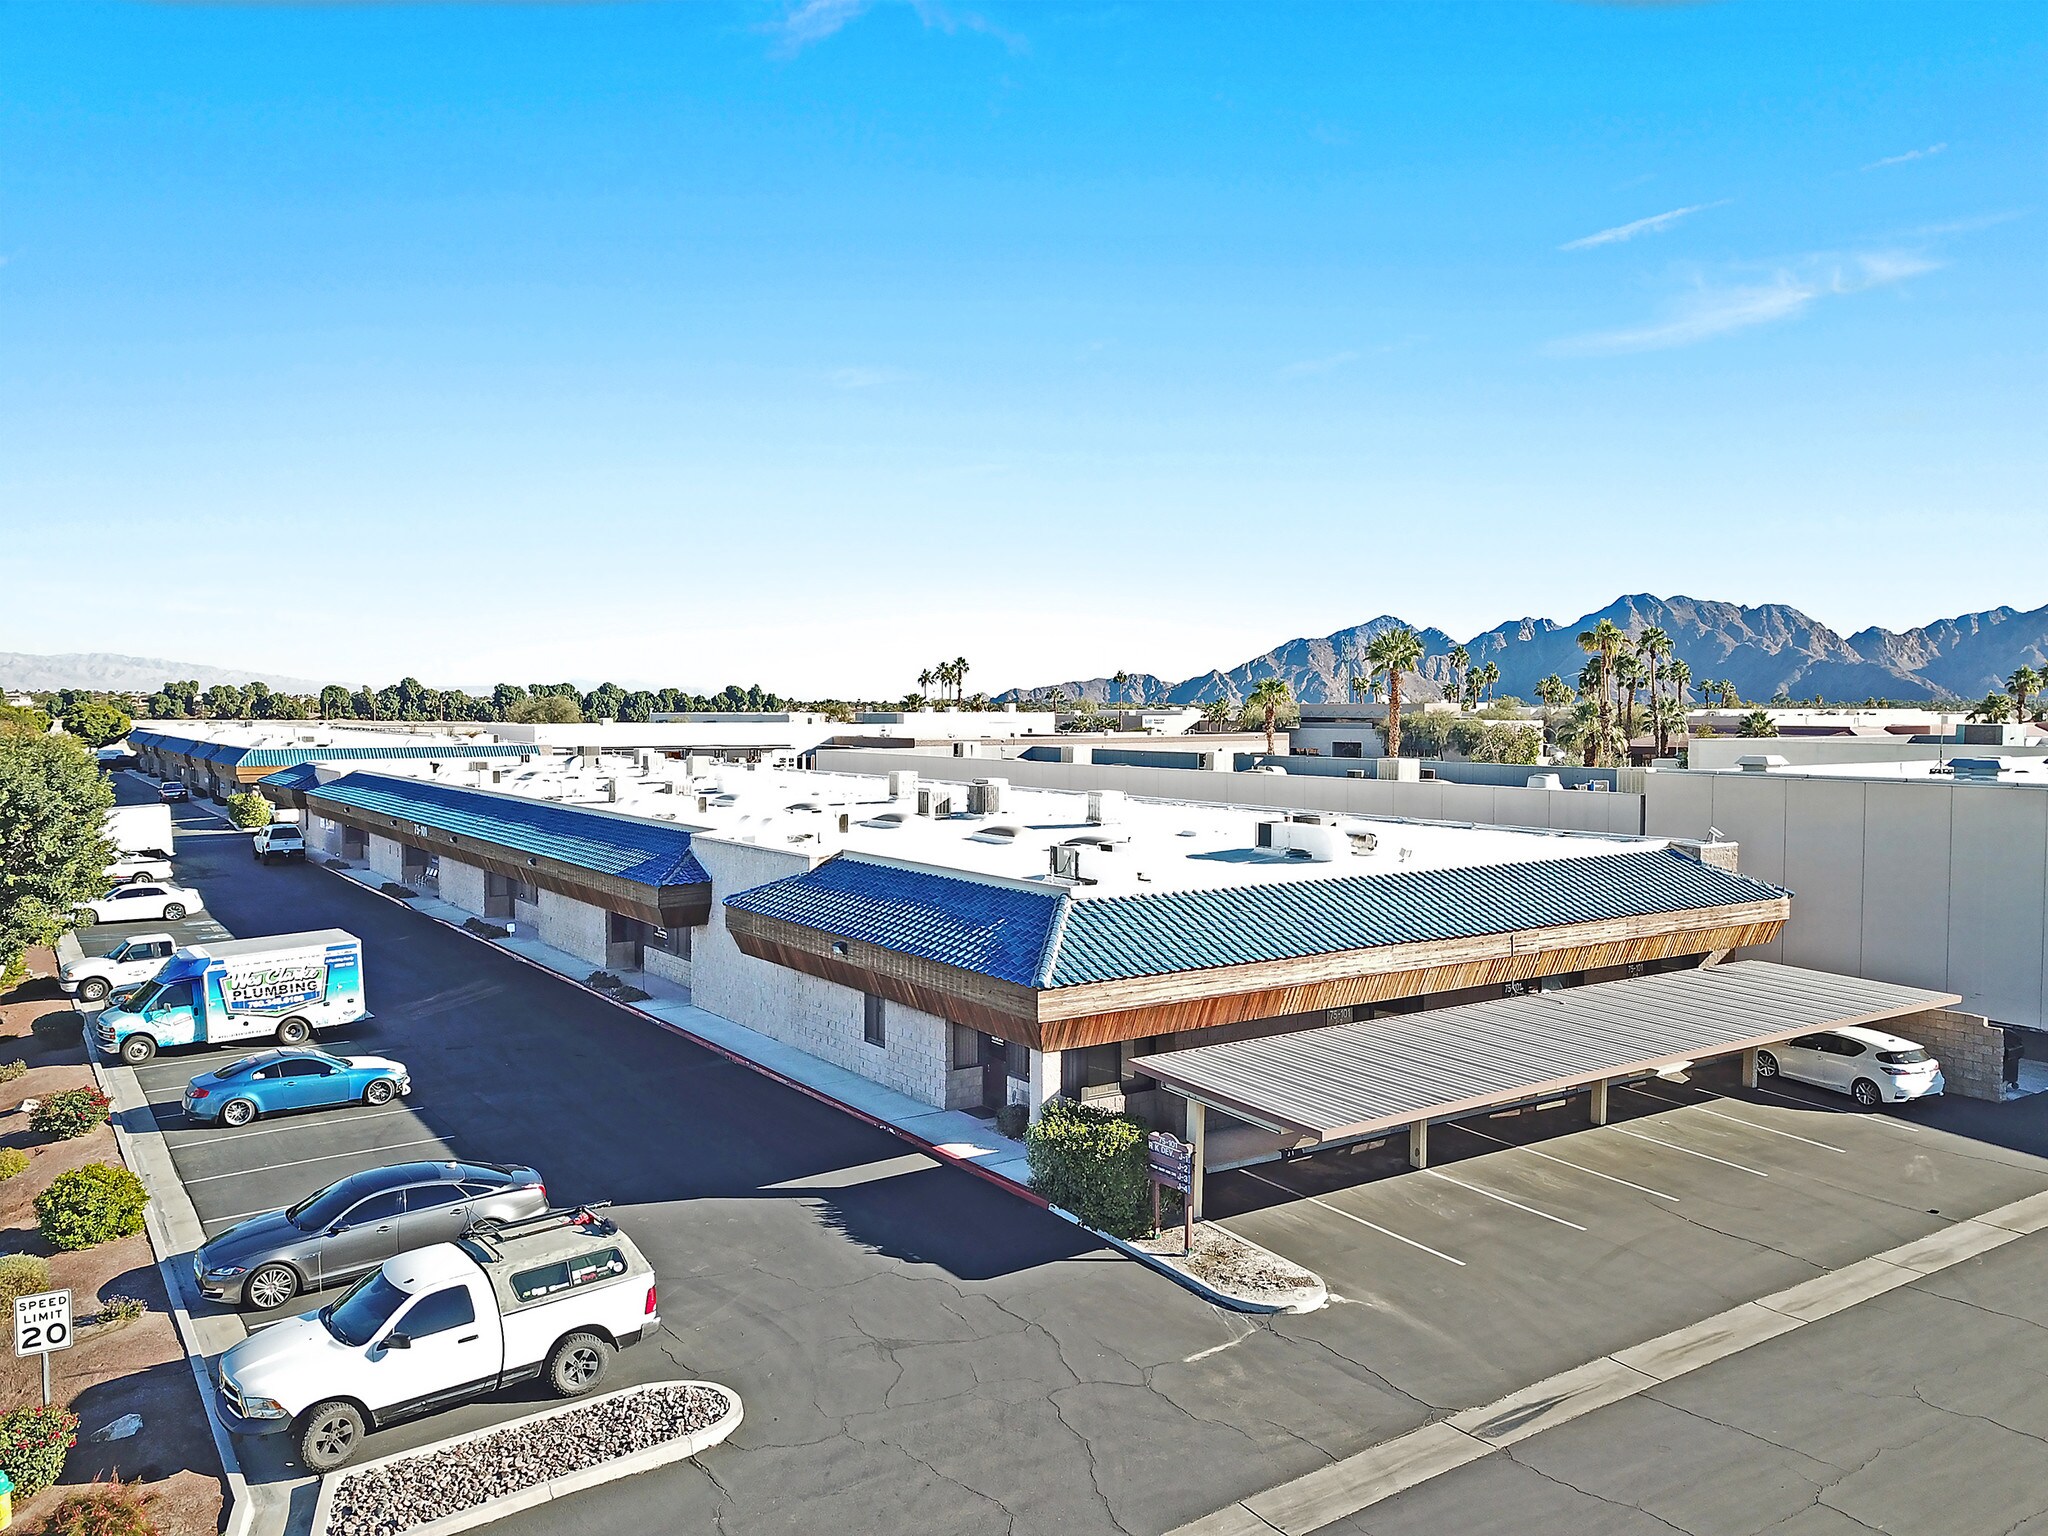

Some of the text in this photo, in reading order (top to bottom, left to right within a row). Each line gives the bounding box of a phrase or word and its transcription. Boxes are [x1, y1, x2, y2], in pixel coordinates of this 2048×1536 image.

[233, 981, 318, 1000] PLUMBING
[1329, 1008, 1351, 1020] 75-101
[1159, 1137, 1178, 1149] 75-101
[1177, 1163, 1188, 1173] J-2
[1177, 1173, 1188, 1183] J-3
[19, 1296, 67, 1311] SPEED
[23, 1309, 63, 1324] LIMIT
[21, 1323, 67, 1349] 20
